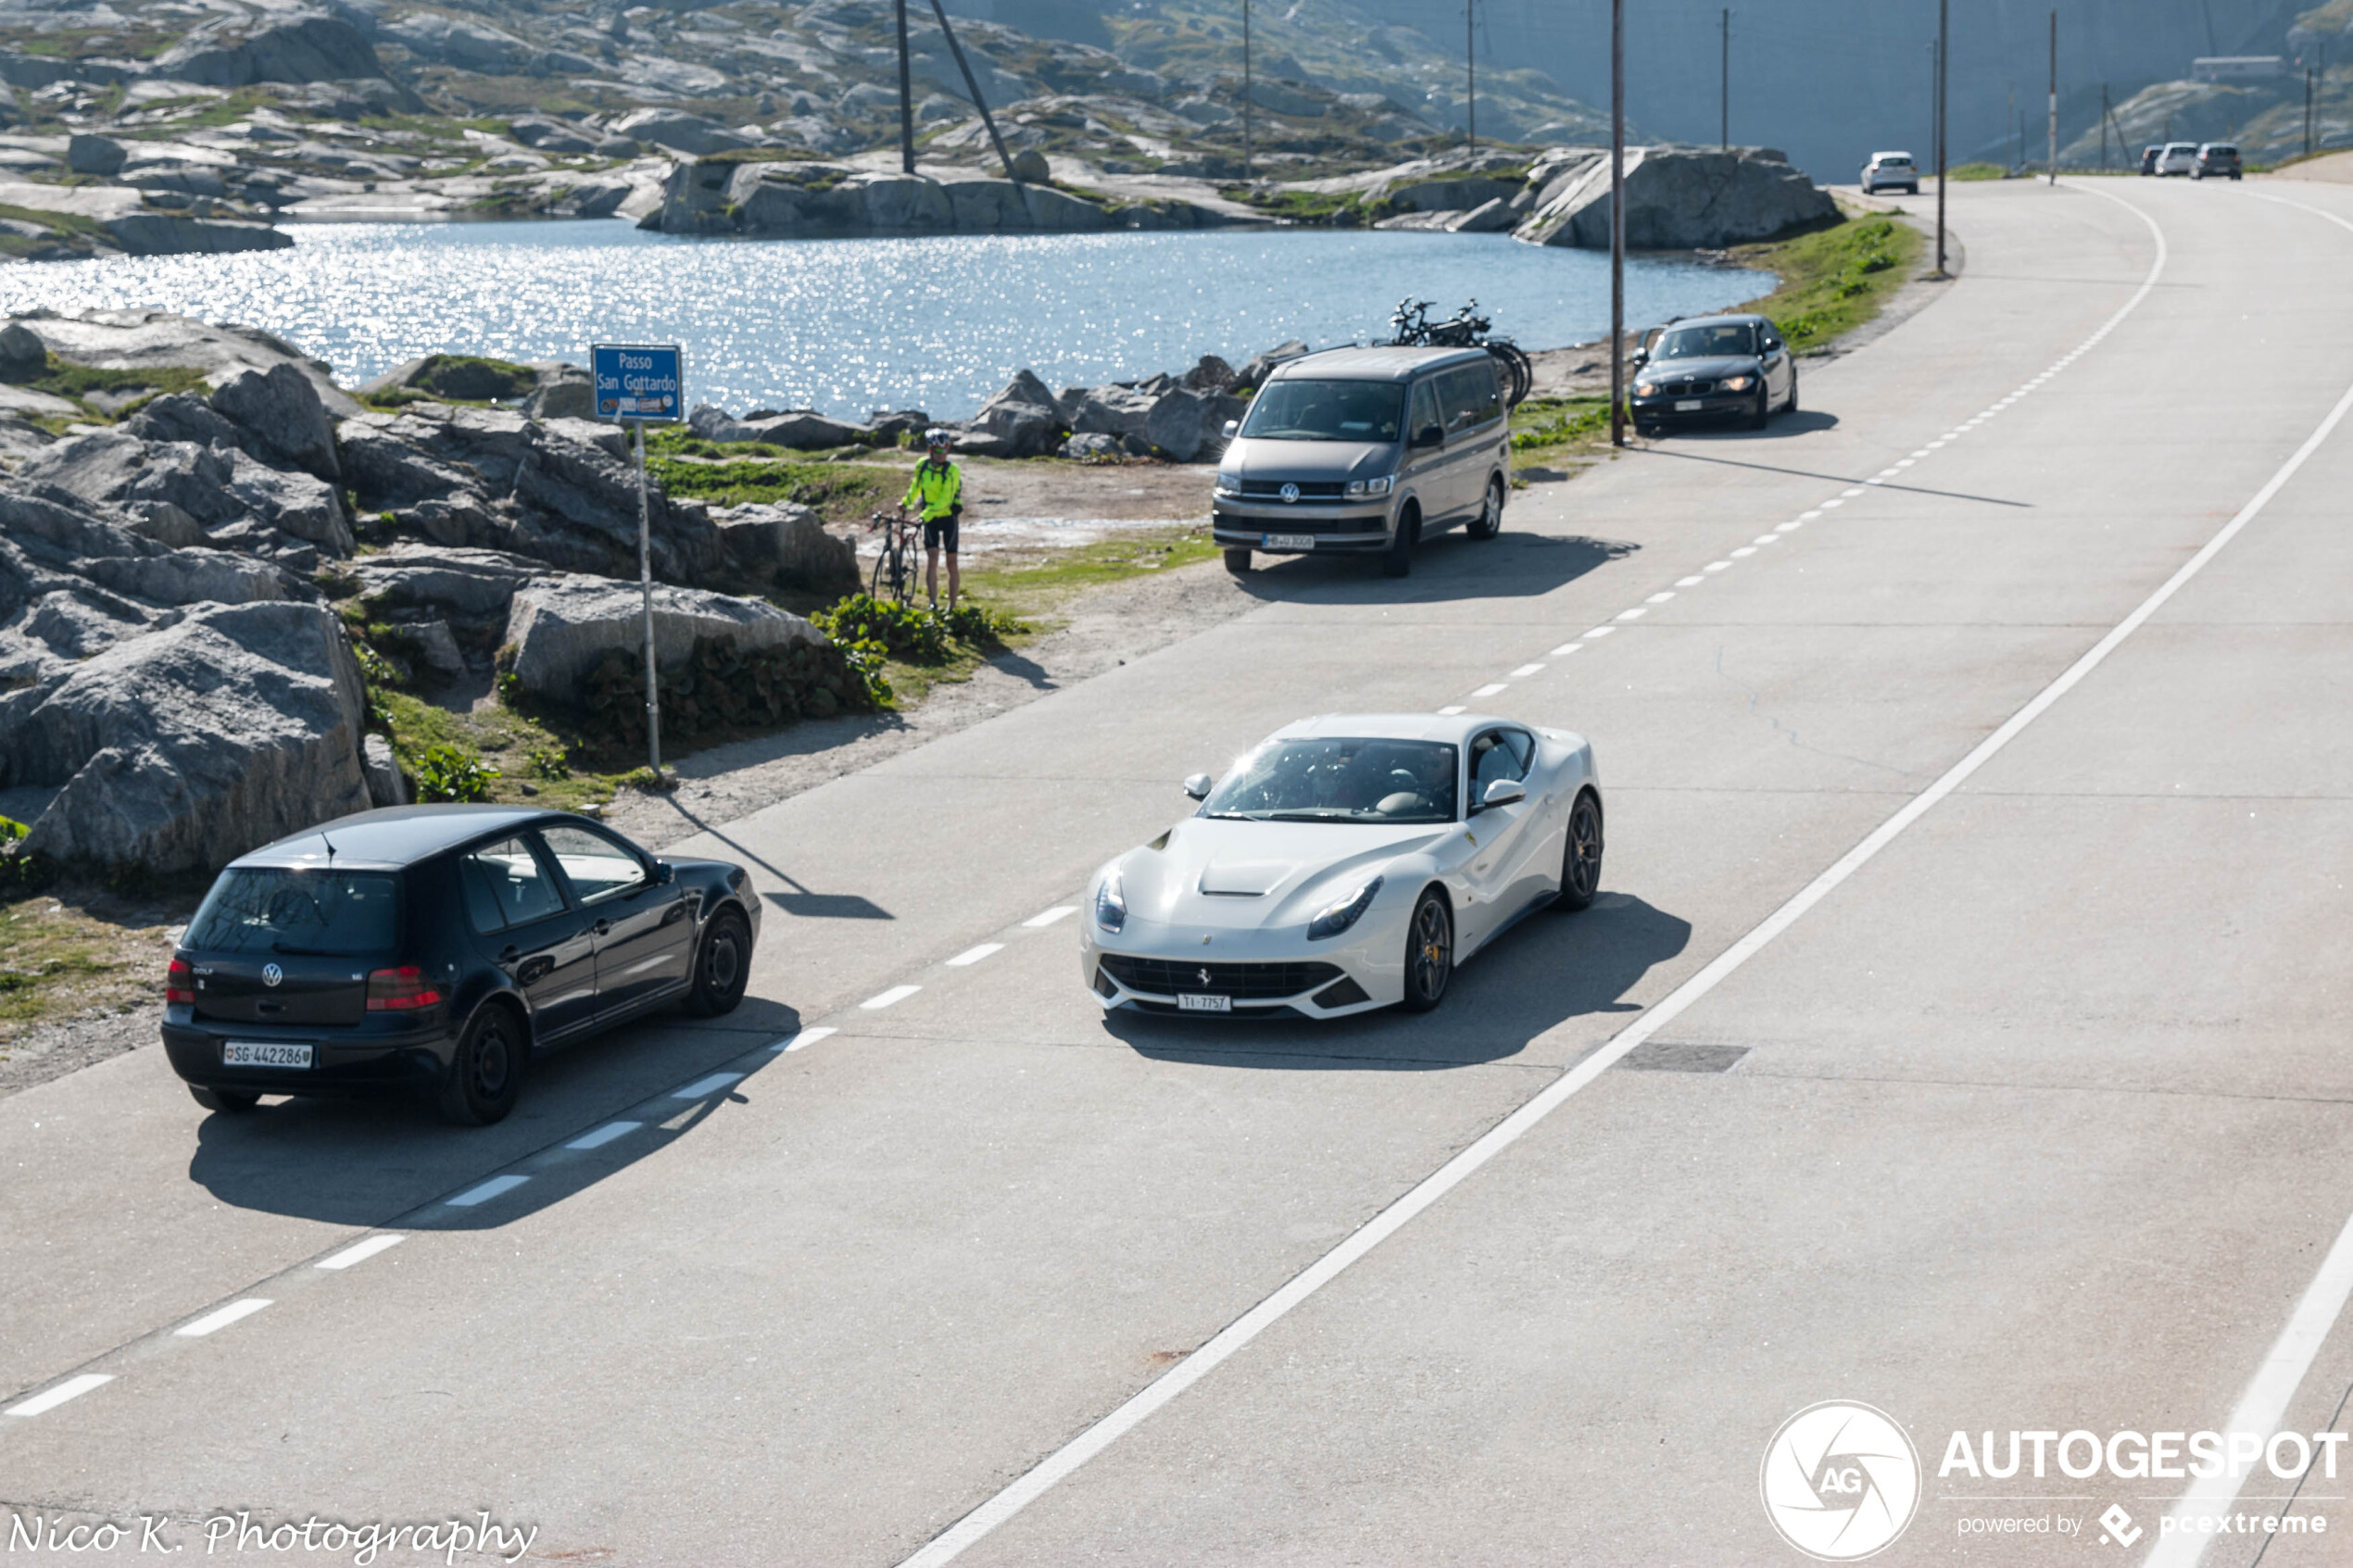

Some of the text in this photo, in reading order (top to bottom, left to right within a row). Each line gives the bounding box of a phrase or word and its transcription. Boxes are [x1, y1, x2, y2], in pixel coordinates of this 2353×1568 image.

[619, 353, 652, 370] Passo
[598, 373, 676, 392] San Gottardo
